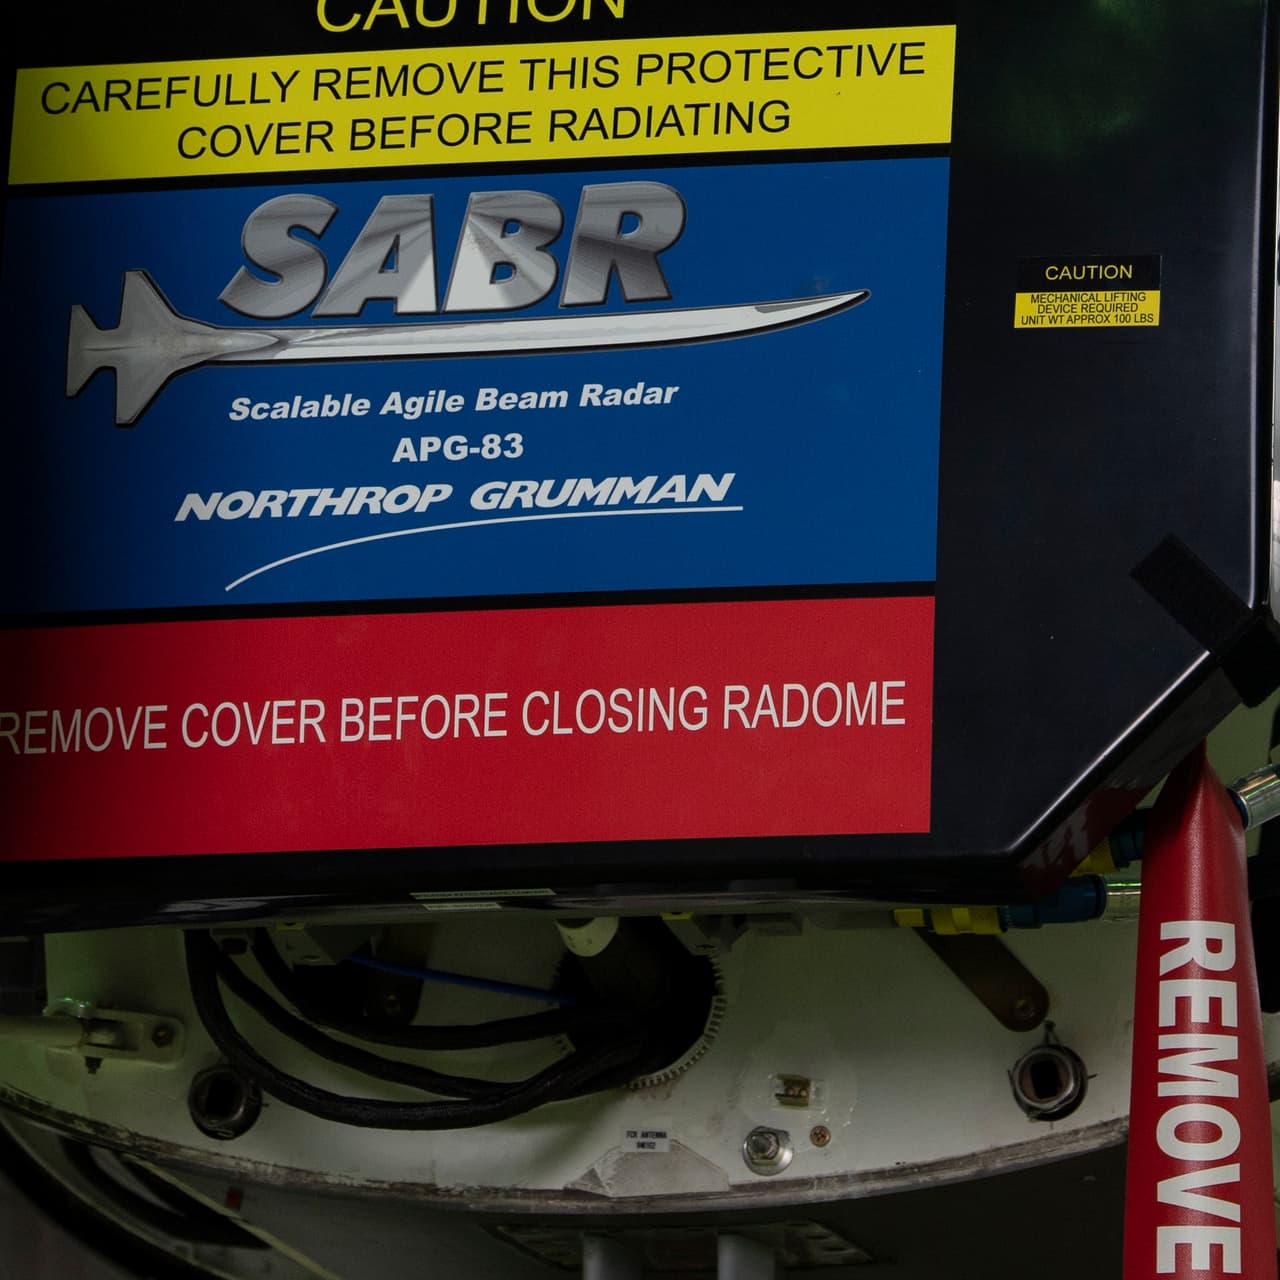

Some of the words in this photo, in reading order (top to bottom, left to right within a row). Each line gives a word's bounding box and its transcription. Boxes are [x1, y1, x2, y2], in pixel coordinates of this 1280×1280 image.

[40, 70, 300, 114] CAREFULLY
[313, 60, 504, 101] REMOVE
[520, 55, 619, 91] THIS
[636, 42, 925, 86] PROTECTIVE
[178, 120, 334, 159] COVER
[350, 111, 532, 151] BEFORE
[549, 100, 790, 142] RADIATING
[217, 182, 687, 320] SABR
[1045, 265, 1132, 280] CAUTION
[1021, 315, 1046, 325] UNIT
[1048, 314, 1065, 324] WT
[1066, 314, 1111, 324] APPROX
[1114, 313, 1131, 324] 100
[1134, 313, 1154, 323] LBS
[1031, 293, 1101, 304] MECHANICAL
[1104, 292, 1146, 302] LIFTING
[1037, 303, 1078, 314] DEVICE
[1081, 302, 1138, 313] REQUIRED
[229, 393, 371, 421] Scalable
[379, 390, 464, 420] Agile
[475, 388, 568, 411] Beam
[579, 382, 680, 407] Radar
[392, 433, 523, 462] APG-83
[175, 484, 453, 521] NORTHROP
[470, 473, 735, 508] GRUMMAN
[182, 699, 326, 748] COVER
[340, 693, 508, 742] BEFORE
[522, 686, 708, 736] CLOSING
[724, 681, 905, 729] RADOME
[1156, 920, 1241, 1274] REMOVE
